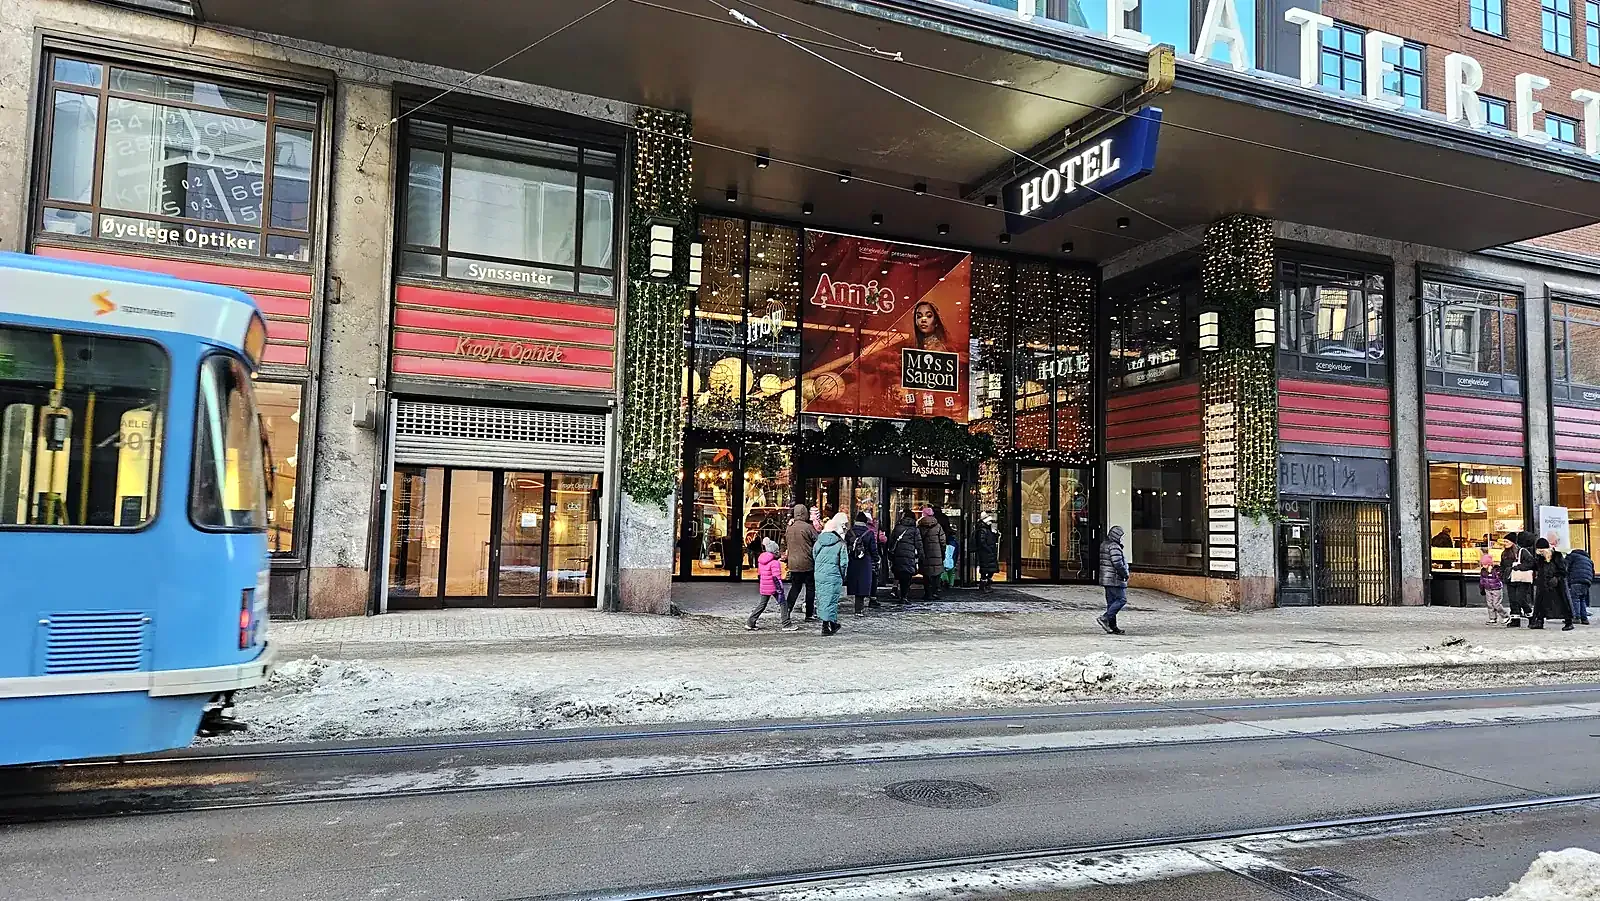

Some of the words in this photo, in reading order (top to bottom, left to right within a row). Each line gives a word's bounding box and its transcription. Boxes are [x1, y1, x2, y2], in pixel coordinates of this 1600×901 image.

[1020, 139, 1120, 215] HOTEL
[101, 217, 179, 245] Øyelege
[186, 228, 256, 251] Optiker
[468, 262, 554, 286] Synssenter
[809, 272, 896, 313] Annie
[454, 336, 505, 361] Krogh
[509, 342, 563, 364] Optikk
[905, 368, 955, 389] Saigon
[1315, 361, 1352, 373] scenekvelder
[911, 466, 950, 477] PASSASJEN
[926, 459, 949, 468] TEATER
[1280, 462, 1327, 488] REVIR
[1473, 474, 1513, 486] NARVESEN
